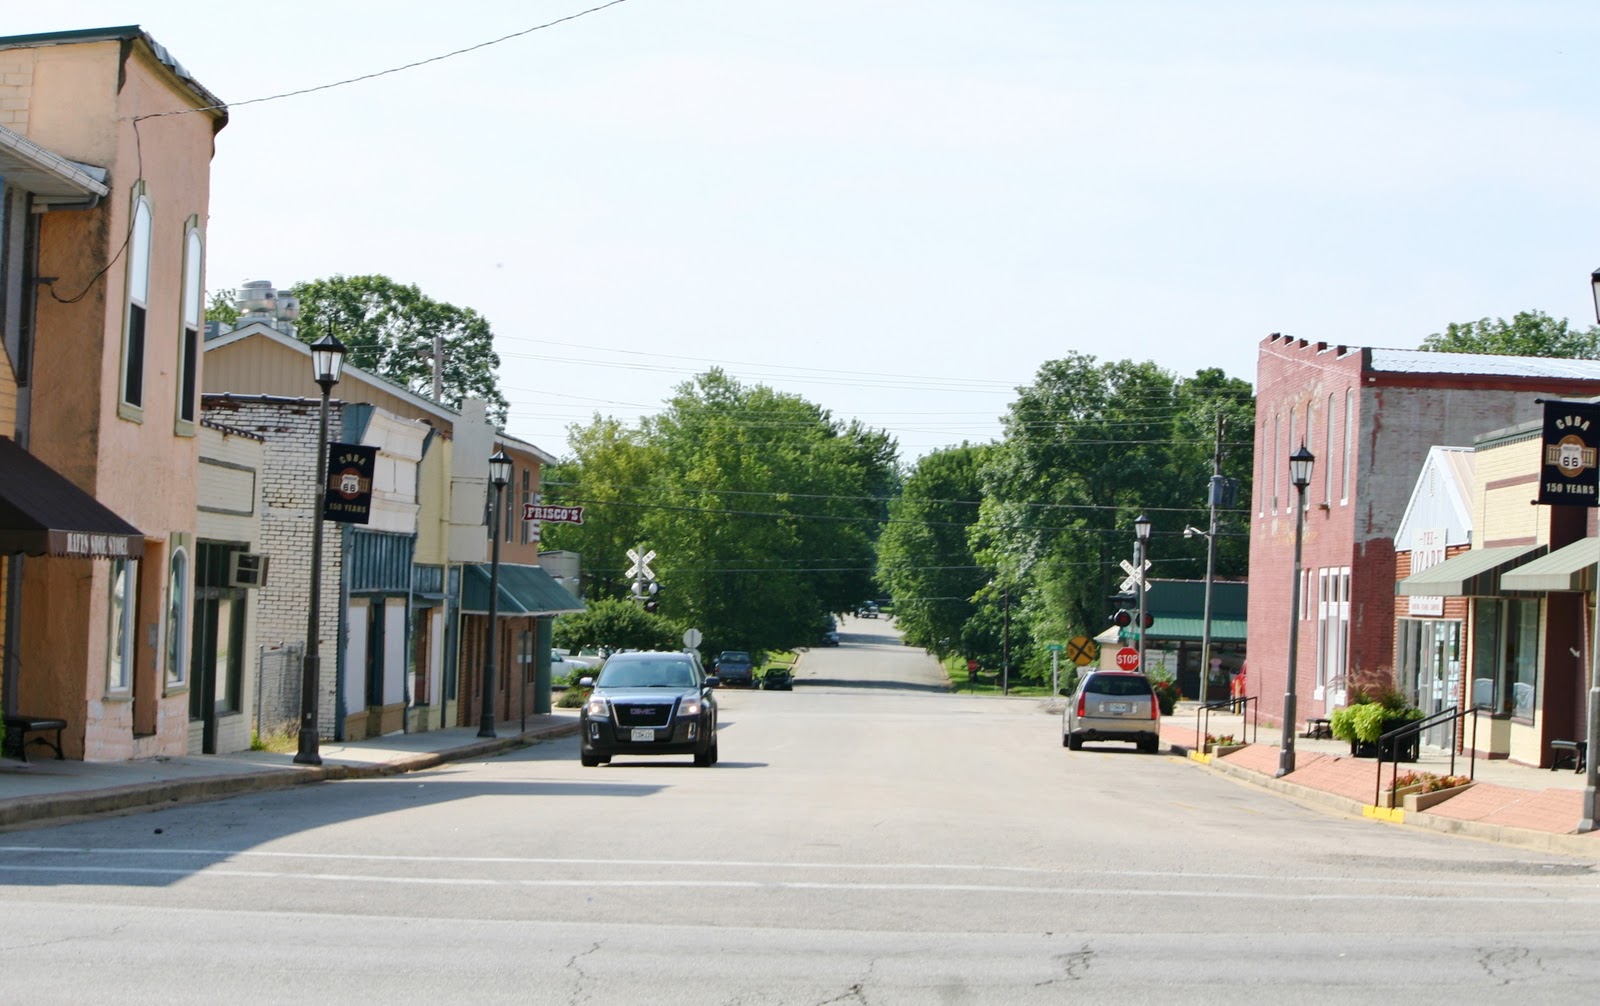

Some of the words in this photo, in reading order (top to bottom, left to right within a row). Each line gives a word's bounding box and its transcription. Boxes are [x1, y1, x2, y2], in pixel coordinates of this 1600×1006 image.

[1556, 415, 1591, 431] CUBA
[339, 453, 366, 466] CUBA
[1562, 456, 1579, 467] 66
[343, 483, 356, 492] 66
[1546, 482, 1563, 493] 150
[1566, 483, 1595, 494] YEARS
[344, 504, 367, 513] YEARS
[527, 506, 579, 521] FRISCO'S
[1117, 654, 1139, 665] STOP
